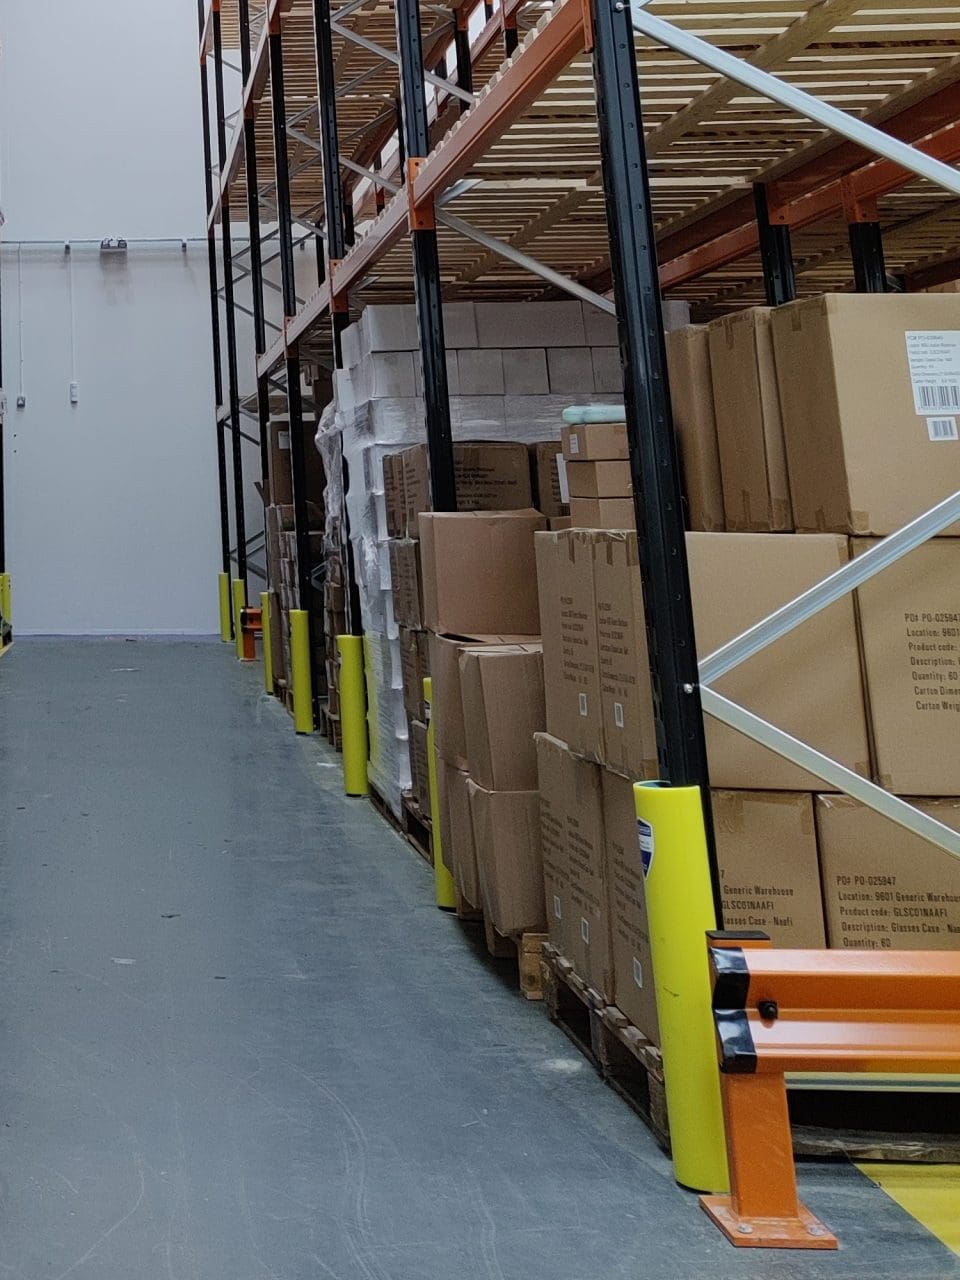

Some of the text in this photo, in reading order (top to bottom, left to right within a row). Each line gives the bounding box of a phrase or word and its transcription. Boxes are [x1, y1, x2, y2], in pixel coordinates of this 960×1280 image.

[906, 627, 940, 637] Location:
[908, 642, 936, 651] Product
[910, 656, 956, 667] Description:
[912, 671, 946, 682] Quantity:
[914, 686, 939, 695] Carton
[916, 701, 940, 710] Carton
[723, 885, 794, 896] Generic Warehouse
[838, 891, 873, 901] Location:
[895, 892, 925, 902] Generic
[840, 906, 869, 916] Product
[871, 908, 892, 917] code:
[724, 916, 746, 926] lasses
[748, 916, 767, 926] Case
[773, 916, 793, 927] Naafi
[841, 921, 889, 932] Description:
[891, 922, 920, 932] Glasses
[922, 923, 940, 933] Case
[843, 937, 879, 949] Quantity:
